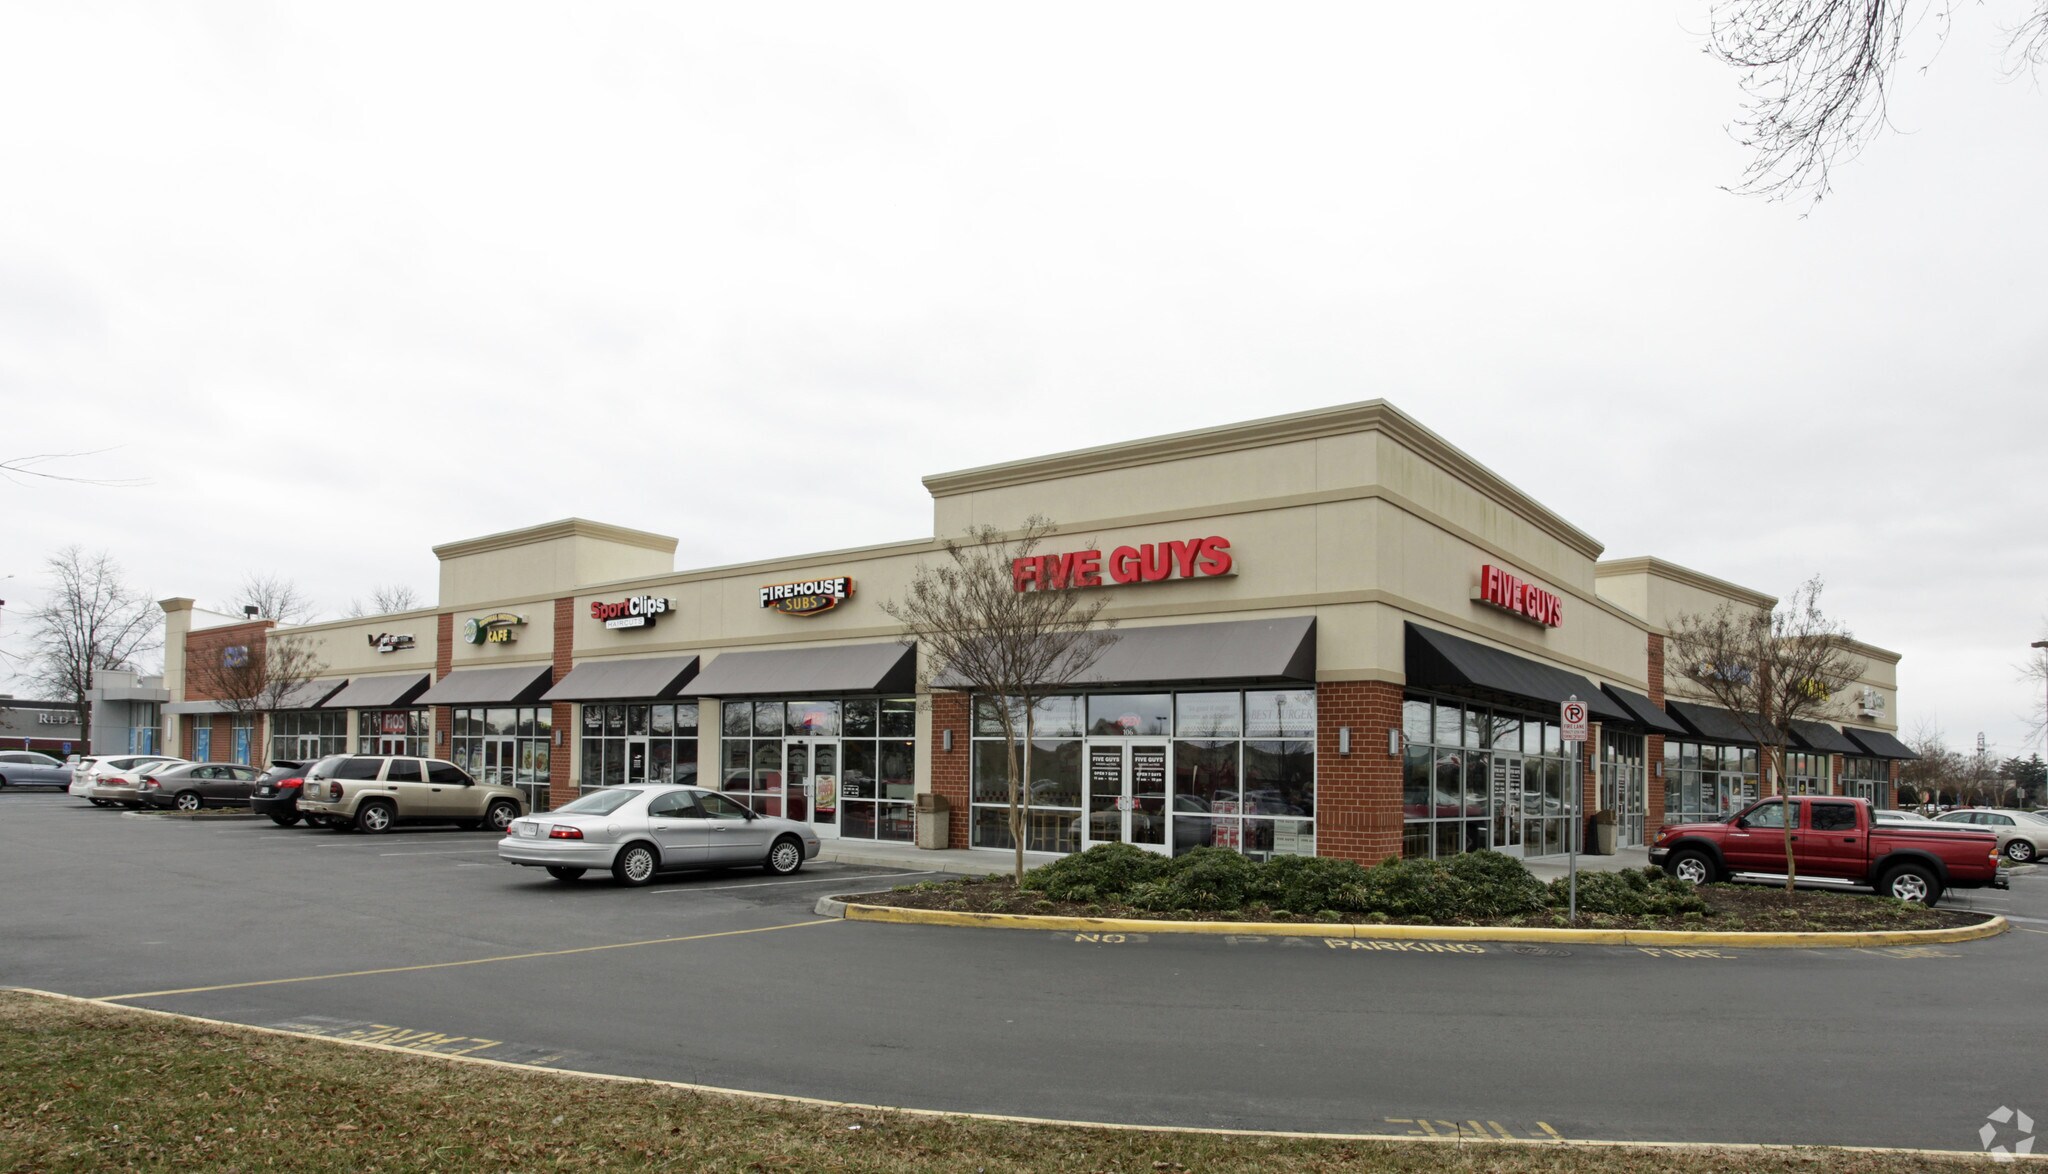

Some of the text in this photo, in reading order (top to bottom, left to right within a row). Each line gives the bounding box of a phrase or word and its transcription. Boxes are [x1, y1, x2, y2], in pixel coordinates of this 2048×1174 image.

[1013, 535, 1233, 592] FIVE GUYS
[759, 577, 845, 608] FIREHOUSE
[1482, 565, 1562, 628] FIVE GUYS
[591, 595, 666, 622] SportClips
[786, 596, 818, 610] SUBS
[607, 618, 643, 628] HAIRCUTS
[488, 629, 508, 642] CAFE
[38, 713, 69, 725] RED
[385, 713, 404, 729] FiOS
[1074, 933, 1126, 944] NO
[1324, 938, 1487, 954] PARKING
